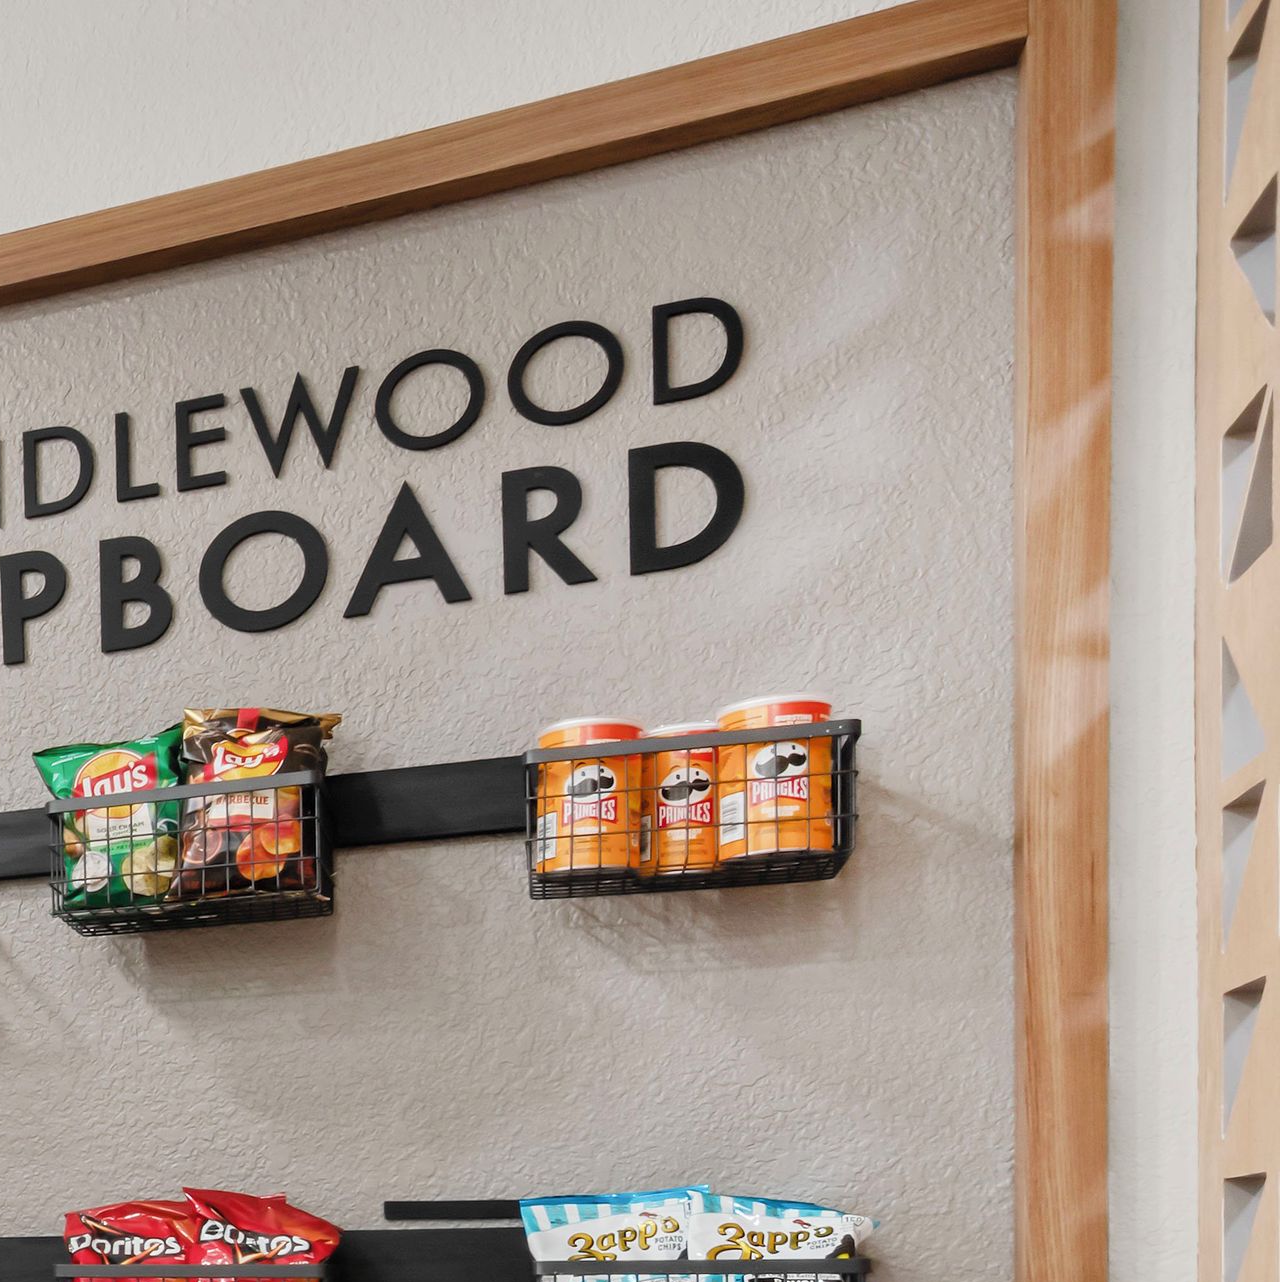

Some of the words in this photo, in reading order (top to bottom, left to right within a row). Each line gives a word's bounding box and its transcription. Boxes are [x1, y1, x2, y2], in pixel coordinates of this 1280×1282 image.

[214, 745, 280, 775] Lay's
[654, 1235, 683, 1244] POTATO
[806, 1237, 837, 1246] POTATO
[69, 1232, 183, 1257] Doritos
[658, 1243, 682, 1252] CHIPS
